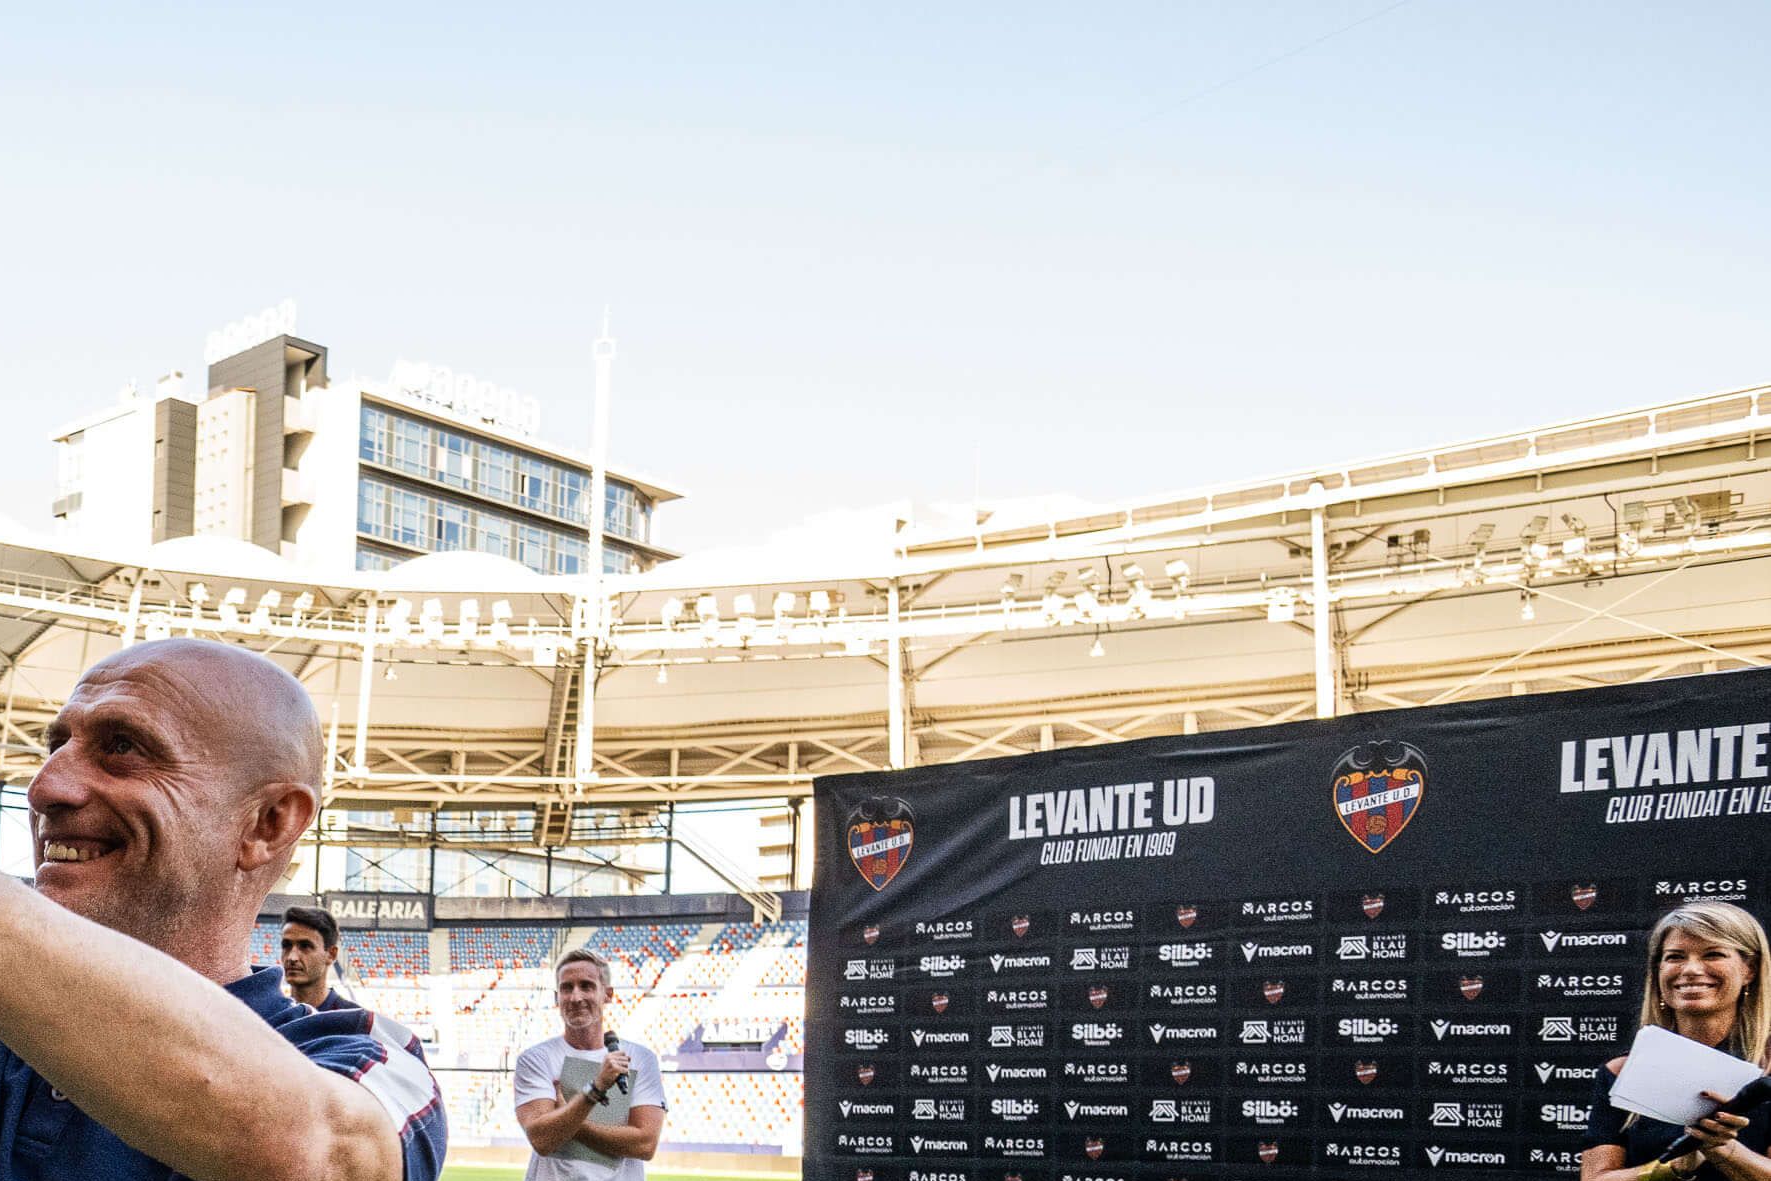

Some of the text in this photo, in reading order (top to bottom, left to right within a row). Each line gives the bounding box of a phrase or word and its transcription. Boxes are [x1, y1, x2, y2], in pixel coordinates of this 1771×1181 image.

[1560, 722, 1770, 793] LEVANTE
[1009, 776, 1215, 840] LEVANTE UD
[1345, 793, 1388, 813] LEVANTE
[1605, 794, 1655, 823] CLUB
[1654, 788, 1728, 821] FUNDAT
[1727, 786, 1756, 815] EN
[1040, 831, 1177, 865] CLUB FUNDAT EN 1909
[1656, 880, 1747, 895] MARCOS
[1436, 891, 1515, 904] MARCOS
[1242, 901, 1312, 914] MARCOS
[1070, 911, 1133, 924] MARCOS
[916, 921, 972, 934] MARCOS
[1562, 933, 1626, 946] macron
[1258, 945, 1312, 956] macron
[1372, 942, 1405, 958] HOME
[1373, 941, 1406, 950] BLAU
[1101, 951, 1129, 961] BLAU
[1004, 956, 1050, 968] macron
[1101, 960, 1129, 969] HOME
[1332, 980, 1406, 991] MARCOS
[1538, 975, 1622, 987] MARCOS
[988, 991, 1047, 1002] MARCOS
[1150, 985, 1216, 997] MARCOS
[1166, 1028, 1216, 1038] macron
[1274, 1026, 1304, 1035] BLAU
[1450, 1025, 1510, 1034] macron
[926, 1033, 969, 1042] macron
[1274, 1034, 1304, 1043] HOME
[1580, 1032, 1616, 1041] HOME
[1001, 1068, 1046, 1078] macron
[1065, 1063, 1127, 1074] MARCOS
[1236, 1062, 1306, 1074] MARCOS
[1429, 1062, 1507, 1074] MARCOS
[1080, 1106, 1128, 1115] macron
[1181, 1106, 1210, 1114] BLAU
[1347, 1108, 1403, 1118] macron
[1468, 1109, 1503, 1118] BLAU
[1181, 1114, 1210, 1123] HOME
[1468, 1118, 1503, 1127] HOME
[924, 1141, 967, 1150] macron
[1146, 1140, 1212, 1152] MARCOS
[1326, 1144, 1400, 1157] MARCOS
[1446, 1152, 1505, 1164] macron
